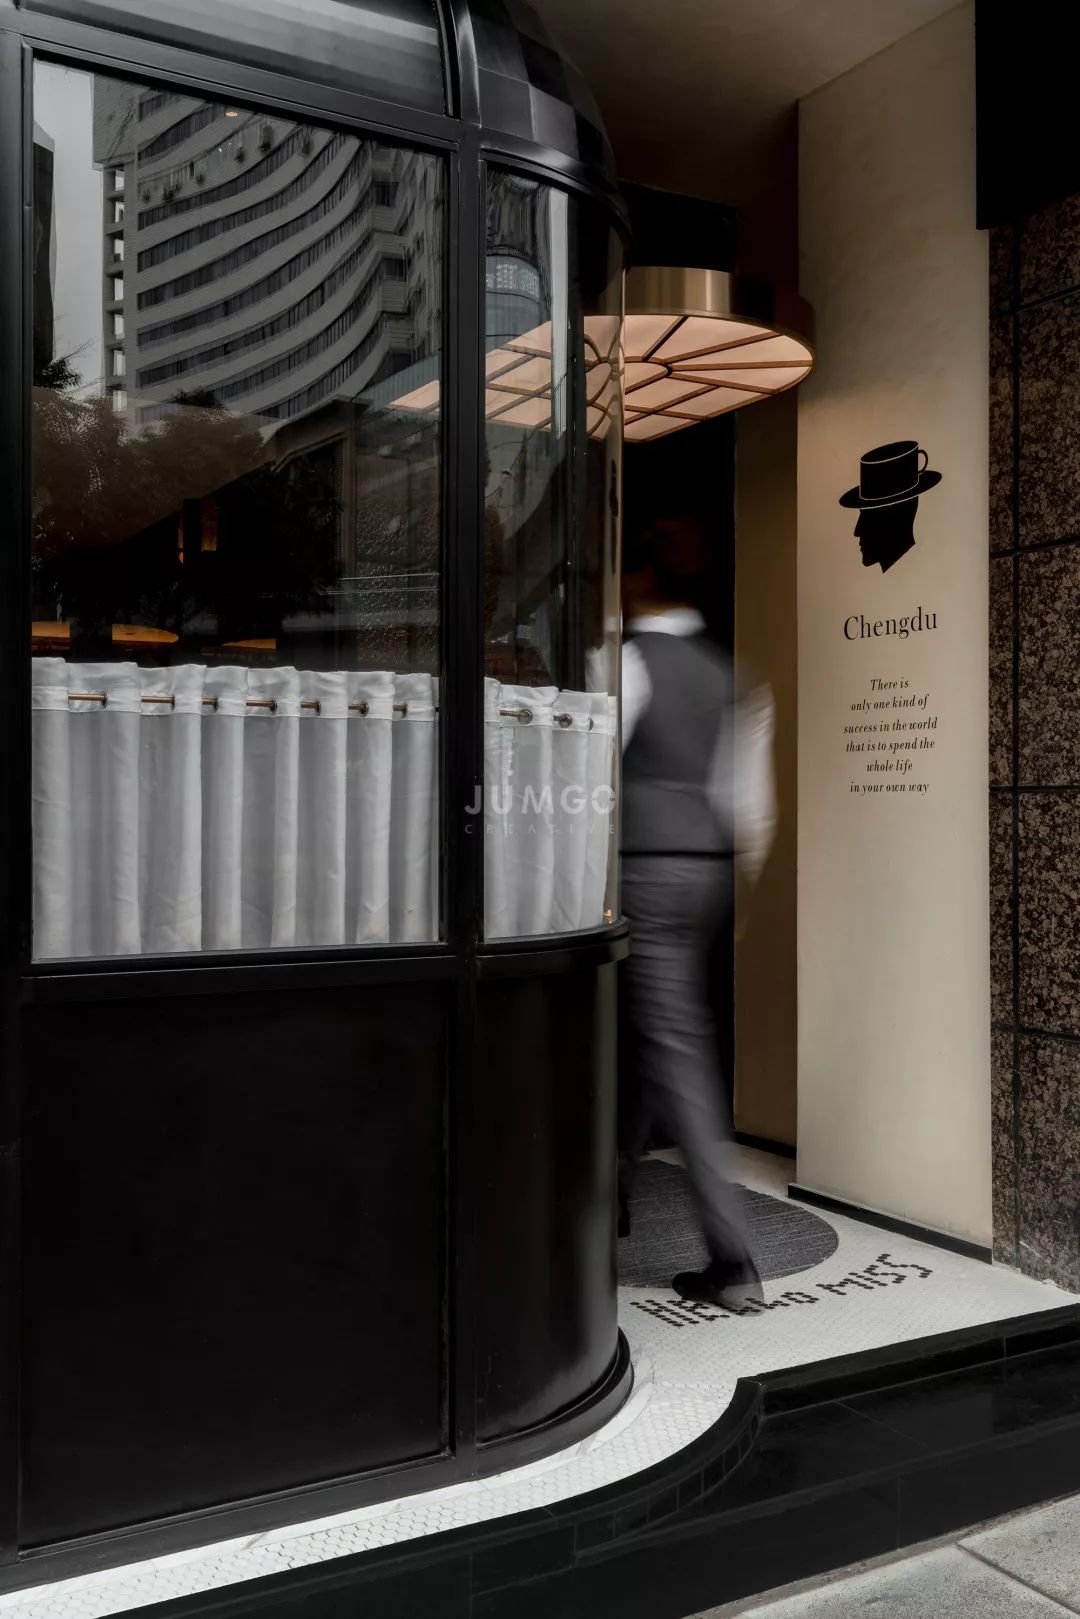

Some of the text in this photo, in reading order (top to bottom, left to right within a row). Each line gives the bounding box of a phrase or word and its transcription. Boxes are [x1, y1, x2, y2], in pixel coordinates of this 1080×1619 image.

[843, 606, 938, 640] Chengdu
[870, 676, 909, 691] There is
[850, 693, 930, 714] only one kind of
[843, 716, 938, 735] success in the world
[845, 736, 935, 754] that is to spend the
[866, 759, 913, 775] whole life
[850, 780, 929, 797] in your own way
[815, 1253, 934, 1296] MISS
